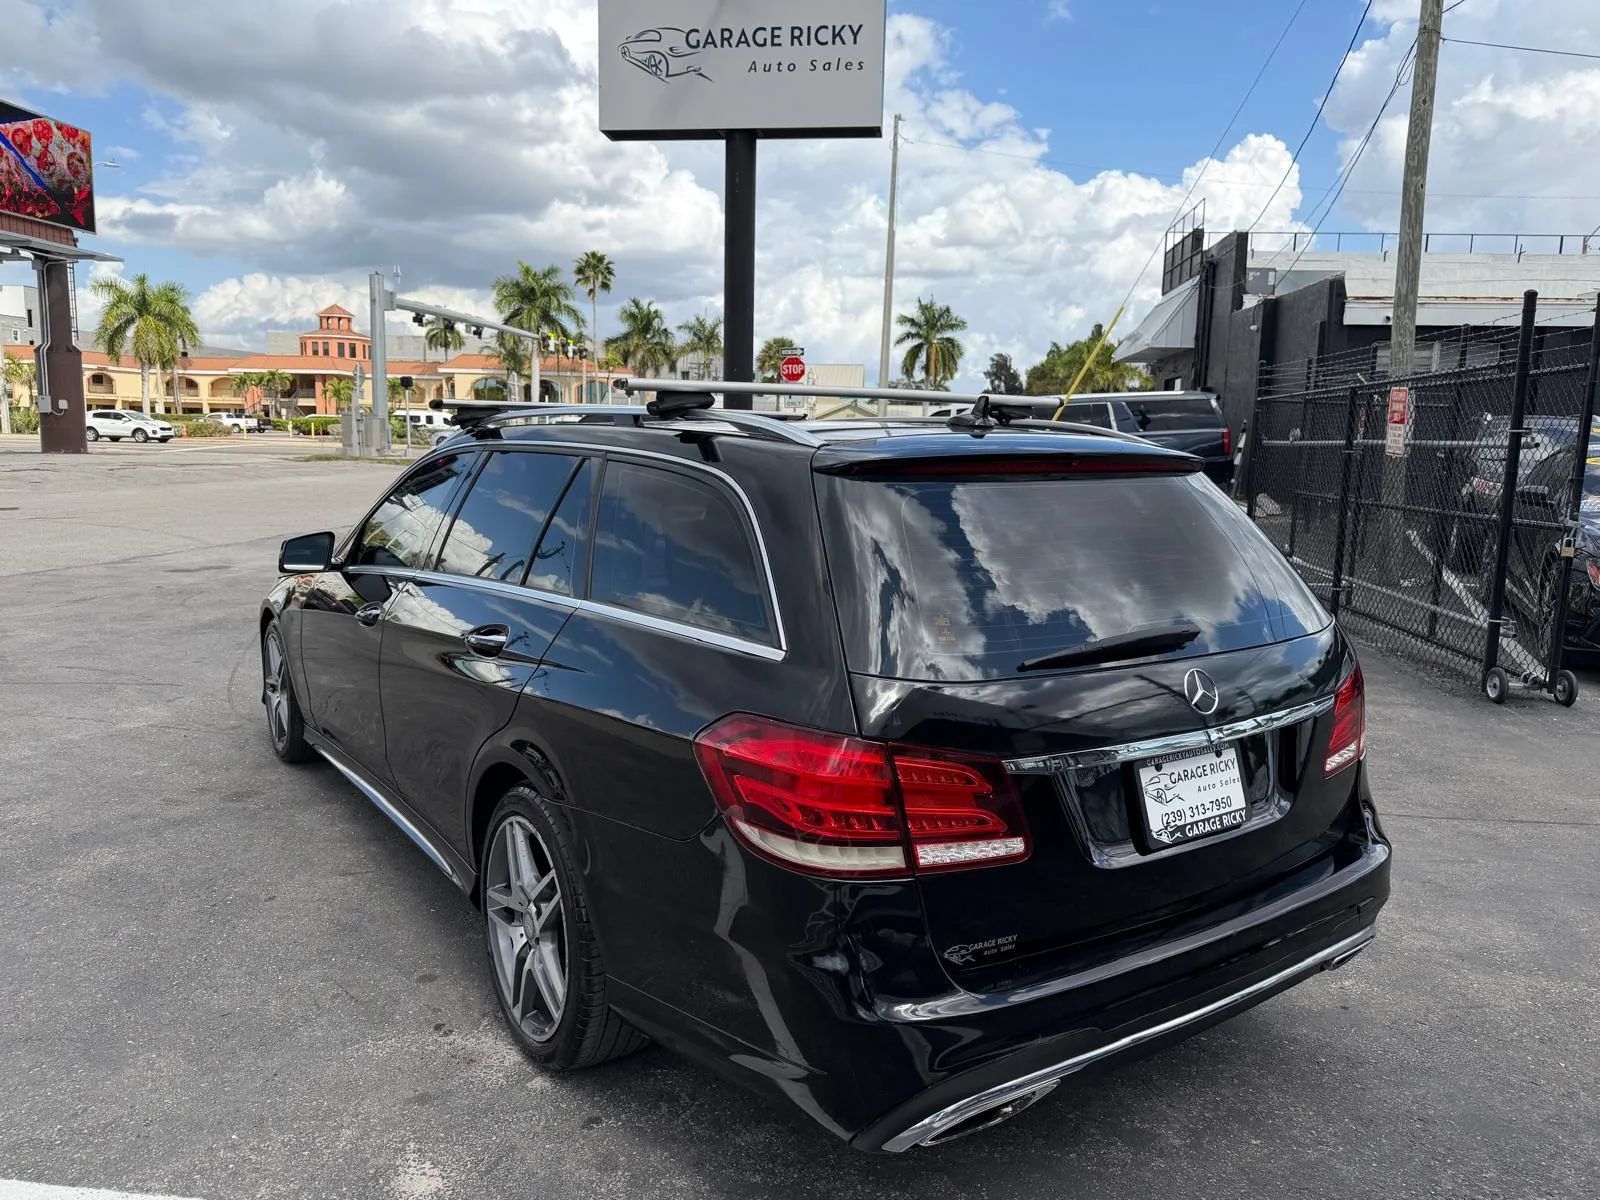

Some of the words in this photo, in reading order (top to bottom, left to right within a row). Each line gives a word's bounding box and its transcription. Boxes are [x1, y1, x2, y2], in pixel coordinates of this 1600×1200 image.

[685, 26, 783, 49] GARAGE
[790, 24, 864, 46] RICKY
[748, 60, 796, 73] Auto
[809, 58, 865, 72] Sales
[782, 364, 804, 375] STOP
[1169, 764, 1209, 785] GARAGE
[1210, 758, 1236, 775] RICKY
[1197, 783, 1216, 793] Auto
[1220, 776, 1240, 787] Sales
[1161, 808, 1187, 829] (239)
[1189, 795, 1232, 818] 313-7950
[1185, 816, 1222, 837] GARAGE
[1222, 808, 1246, 827] RICKY
[968, 939, 996, 951] GARAGE
[997, 934, 1018, 945] RICKY
